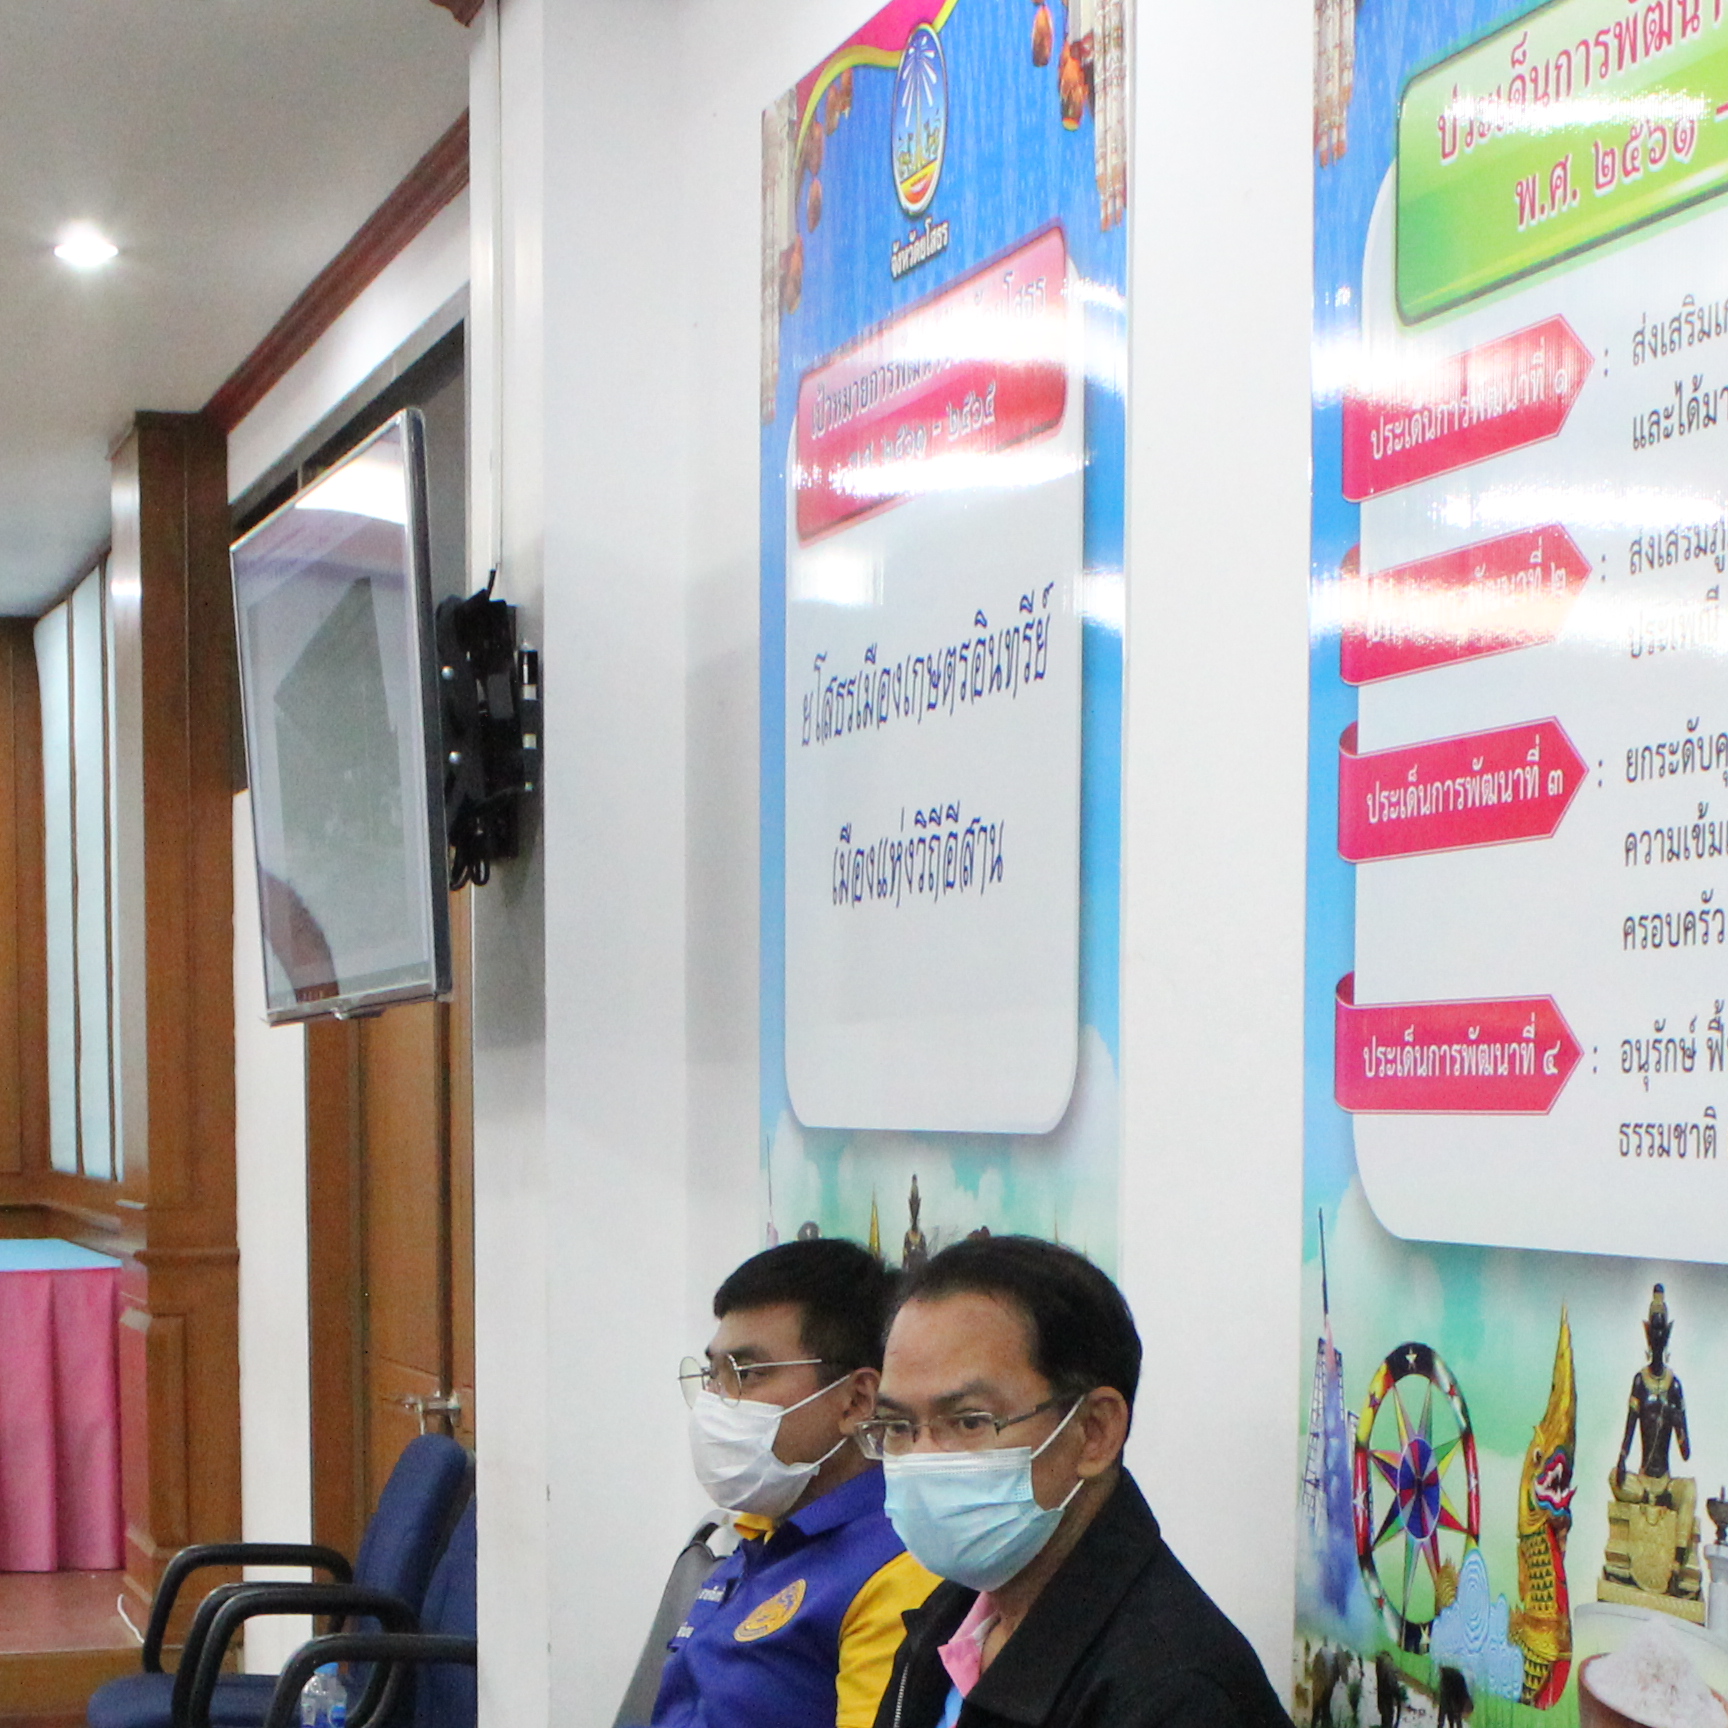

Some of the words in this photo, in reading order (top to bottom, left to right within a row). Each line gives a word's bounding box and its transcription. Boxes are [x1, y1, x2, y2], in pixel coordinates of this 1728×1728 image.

[1515, 153, 1579, 227] พ.ศ.
[801, 580, 1055, 747] ยโสธรเมืองเกษตรอินทรีย์
[1366, 734, 1541, 825] ประเด็นการพัฒนาที่
[1547, 767, 1564, 797] ๓
[832, 800, 1005, 909] เมืองแห่งวิถีอีสาน
[1622, 888, 1726, 951] ครอบครัว
[1363, 1012, 1536, 1078] ประเด็นการพัฒนาที่
[1543, 1039, 1561, 1077] ๔
[1620, 1016, 1699, 1092] อนุรักษ์
[1618, 1105, 1718, 1160] ธรรมชาติ
